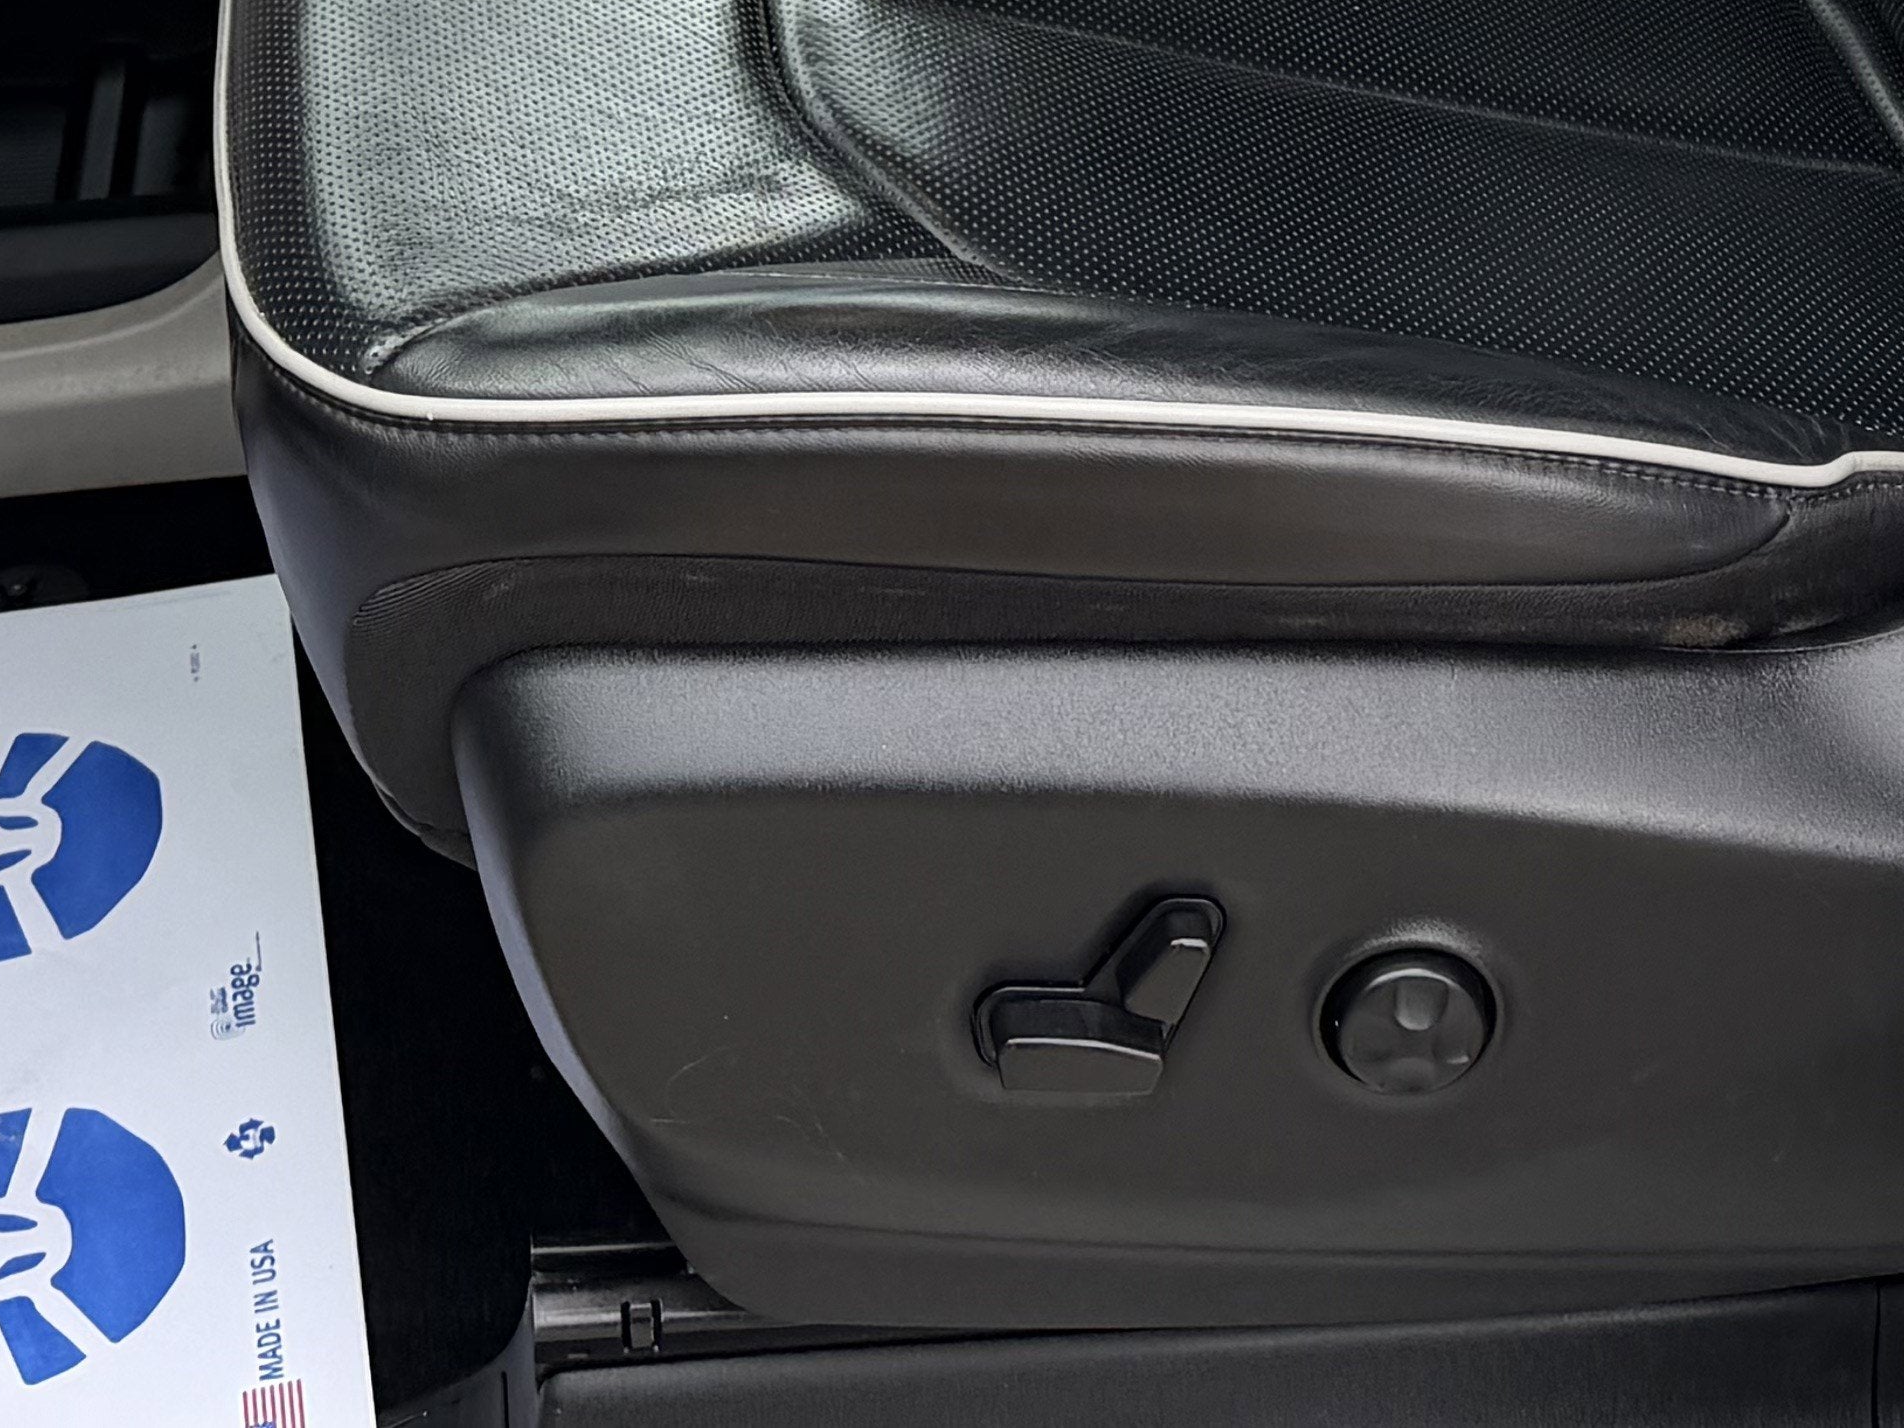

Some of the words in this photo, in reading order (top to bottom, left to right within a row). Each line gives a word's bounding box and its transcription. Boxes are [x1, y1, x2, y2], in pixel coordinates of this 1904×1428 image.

[230, 962, 260, 1028] image
[249, 1238, 276, 1286] USA
[253, 1289, 279, 1314] IN
[256, 1318, 284, 1382] MADE
